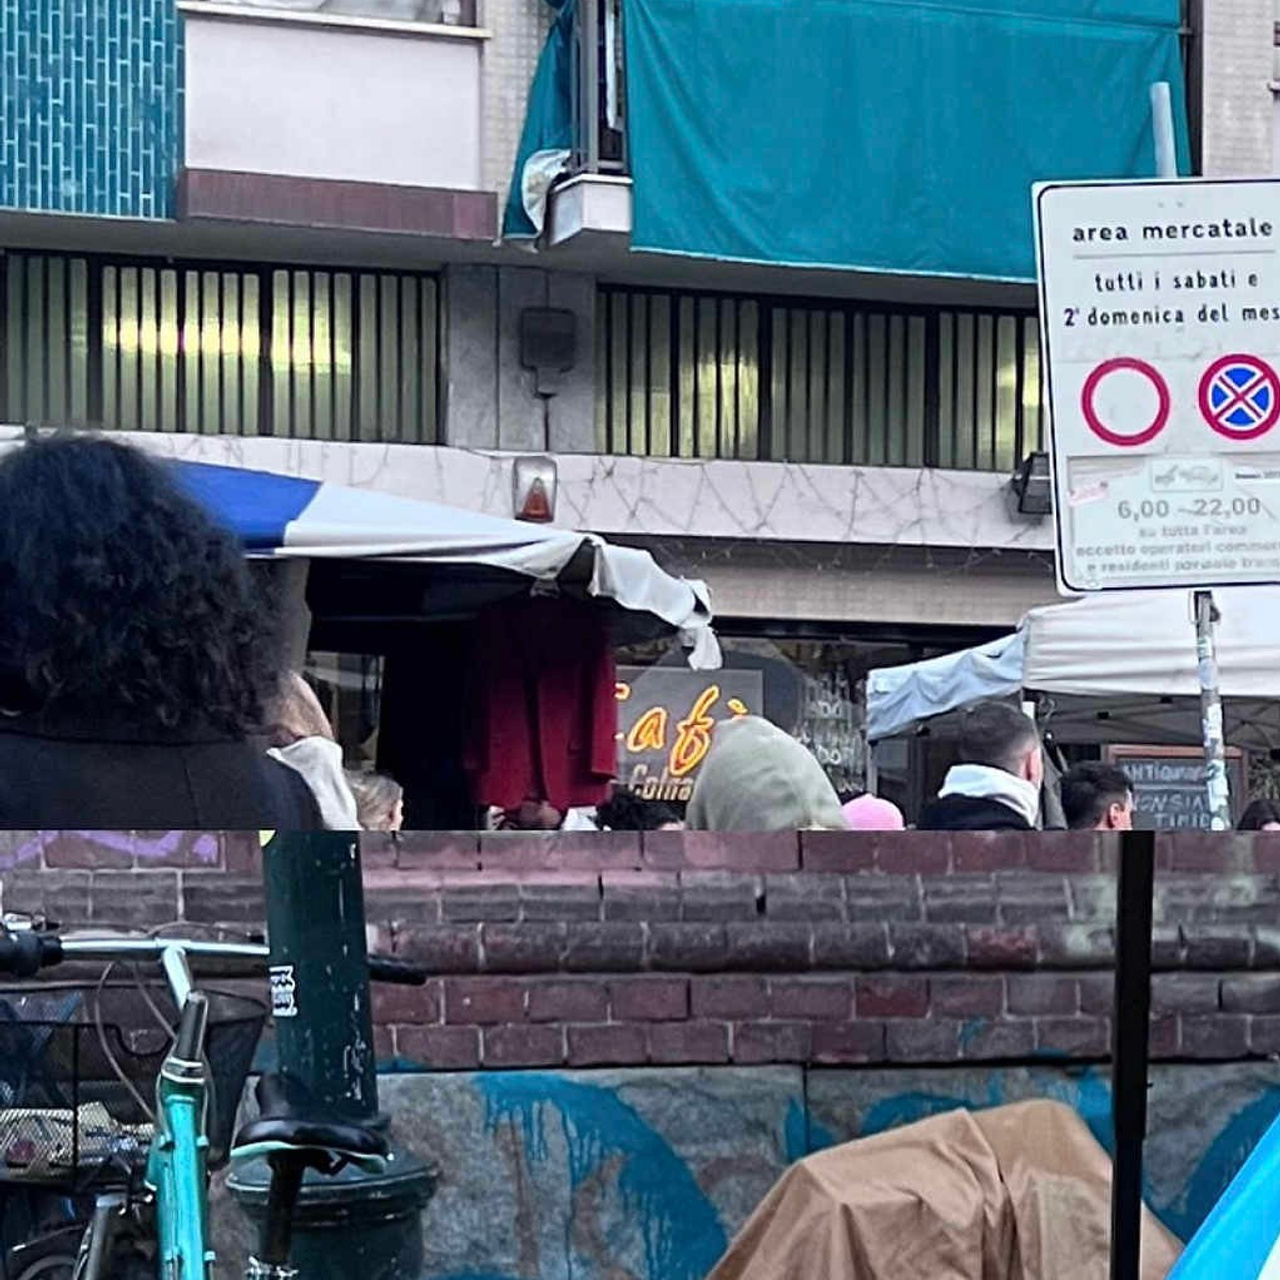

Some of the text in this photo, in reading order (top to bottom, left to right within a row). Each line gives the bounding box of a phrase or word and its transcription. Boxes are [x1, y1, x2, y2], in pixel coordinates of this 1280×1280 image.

[1072, 217, 1274, 242] area mercatale
[1094, 268, 1259, 293] tutti i sabati e
[1087, 306, 1185, 327] domenica
[1197, 303, 1230, 323] del
[1117, 499, 1170, 522] 6,00
[1196, 497, 1263, 520] 22,00
